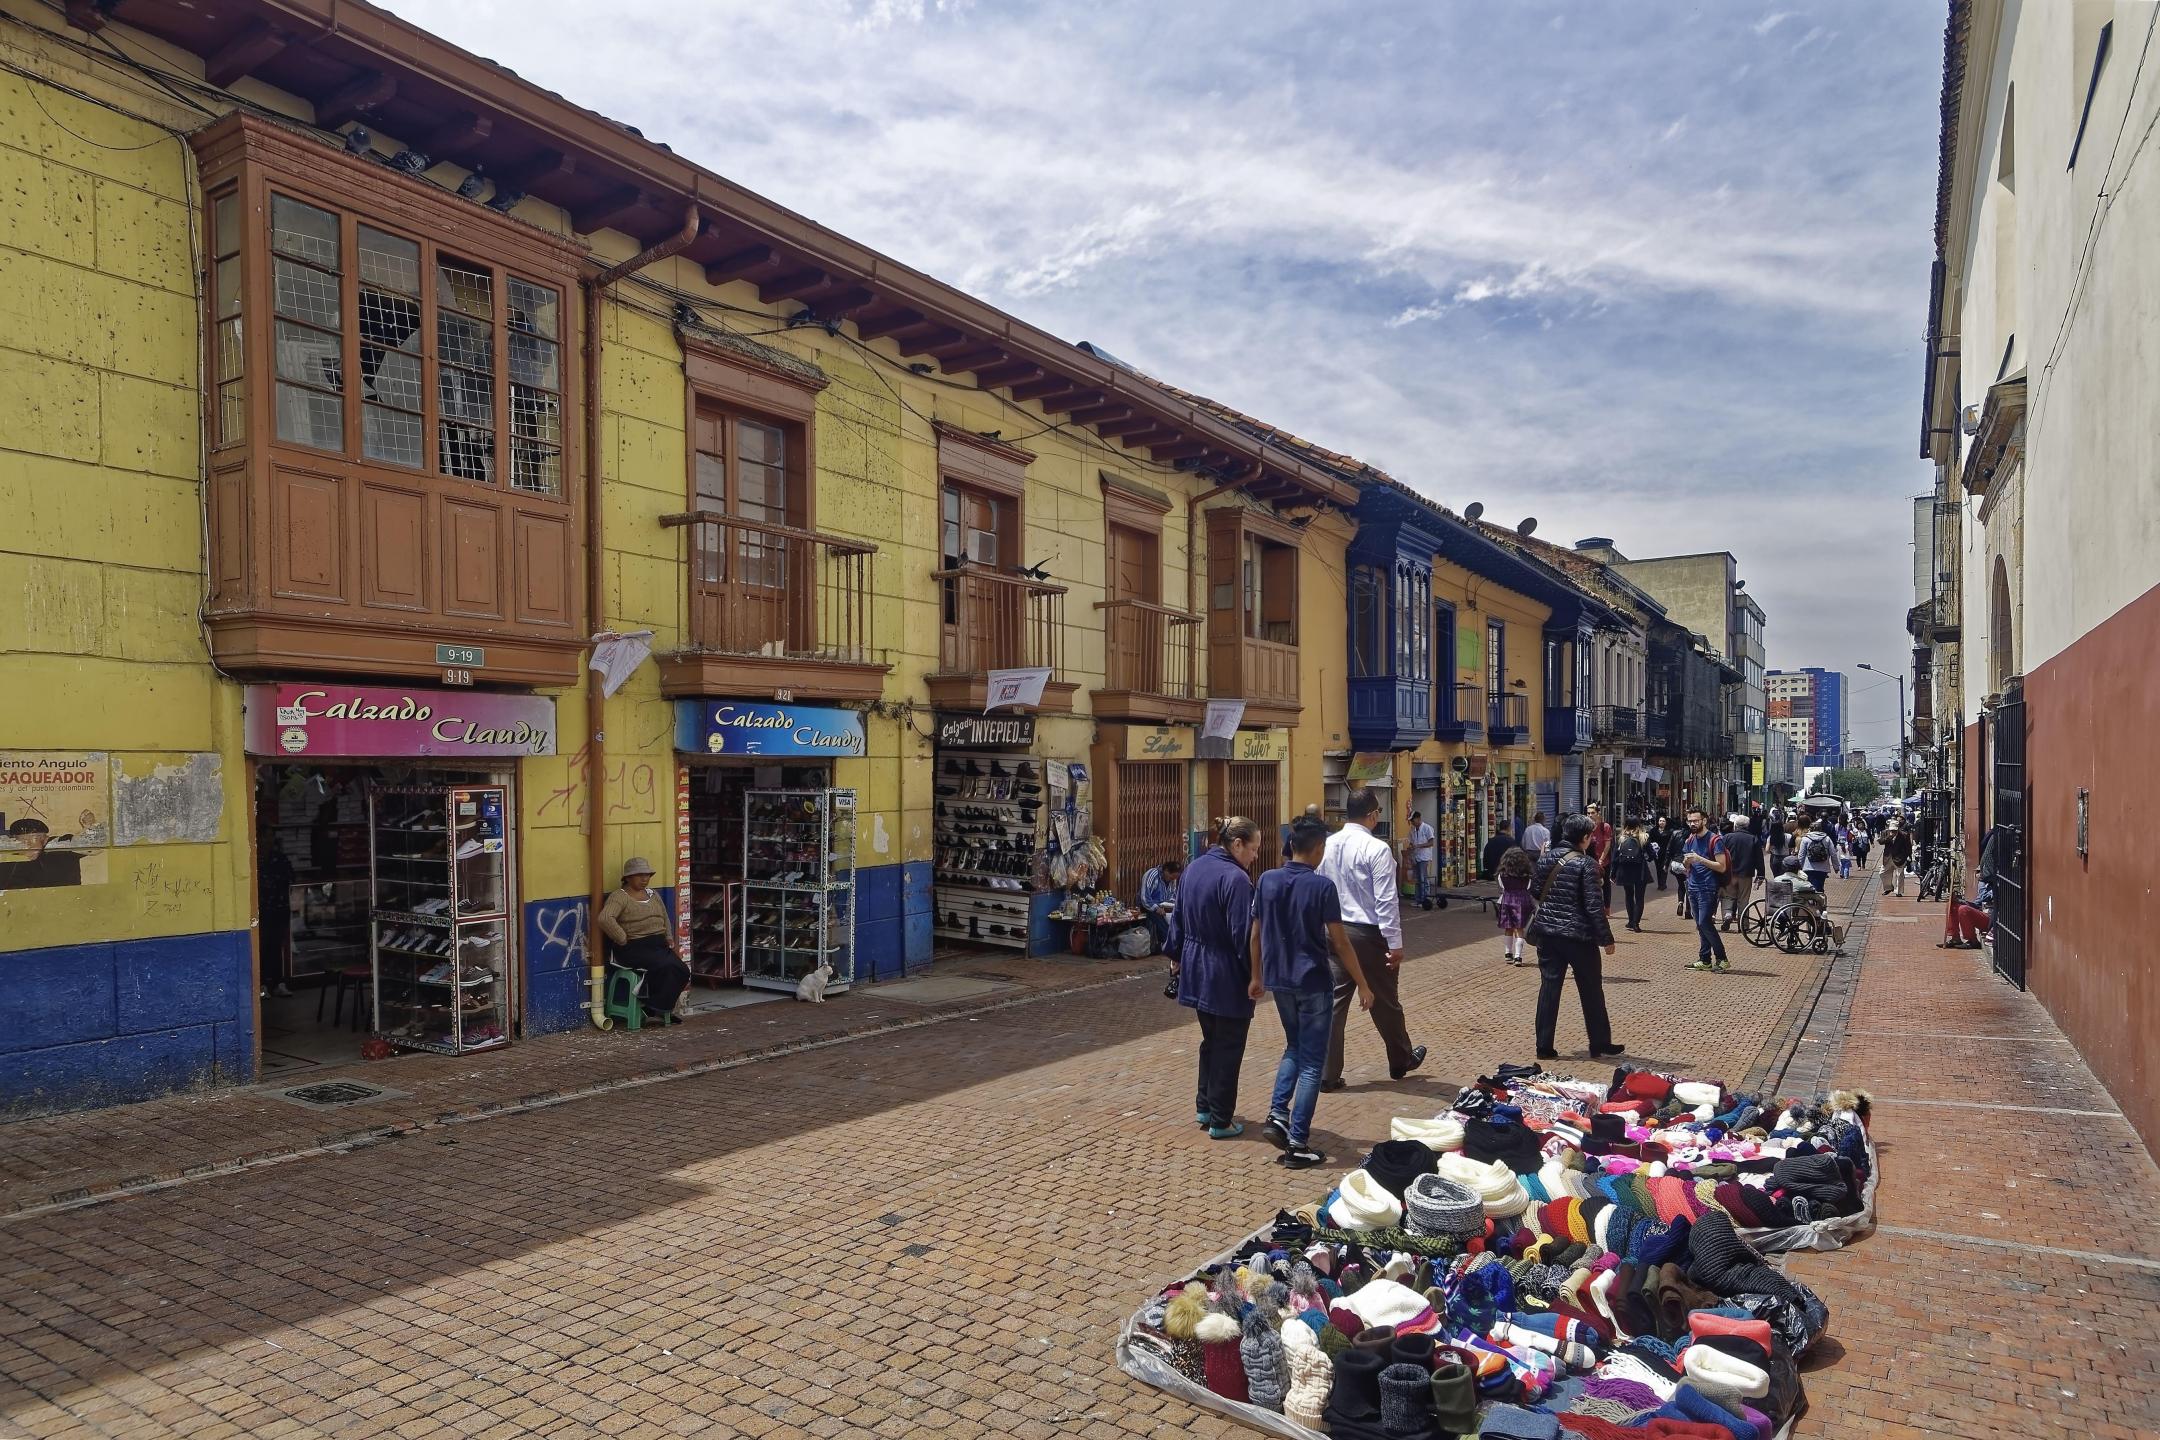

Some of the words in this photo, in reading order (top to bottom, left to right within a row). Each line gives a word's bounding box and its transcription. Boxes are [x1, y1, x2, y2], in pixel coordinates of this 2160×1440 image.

[448, 649, 473, 662] 9-19
[293, 691, 433, 721] Calzado
[715, 706, 794, 729] Calzado
[432, 717, 548, 754] Claudy
[942, 717, 973, 738] Calzado
[971, 720, 1020, 744] INYEPIED
[793, 726, 863, 754] Claudy
[38, 759, 87, 770] Angulo
[0, 772, 95, 784] SAQUEADOR
[31, 785, 55, 793] pueblo
[58, 784, 95, 792] colombiano
[838, 798, 851, 806] VISA
